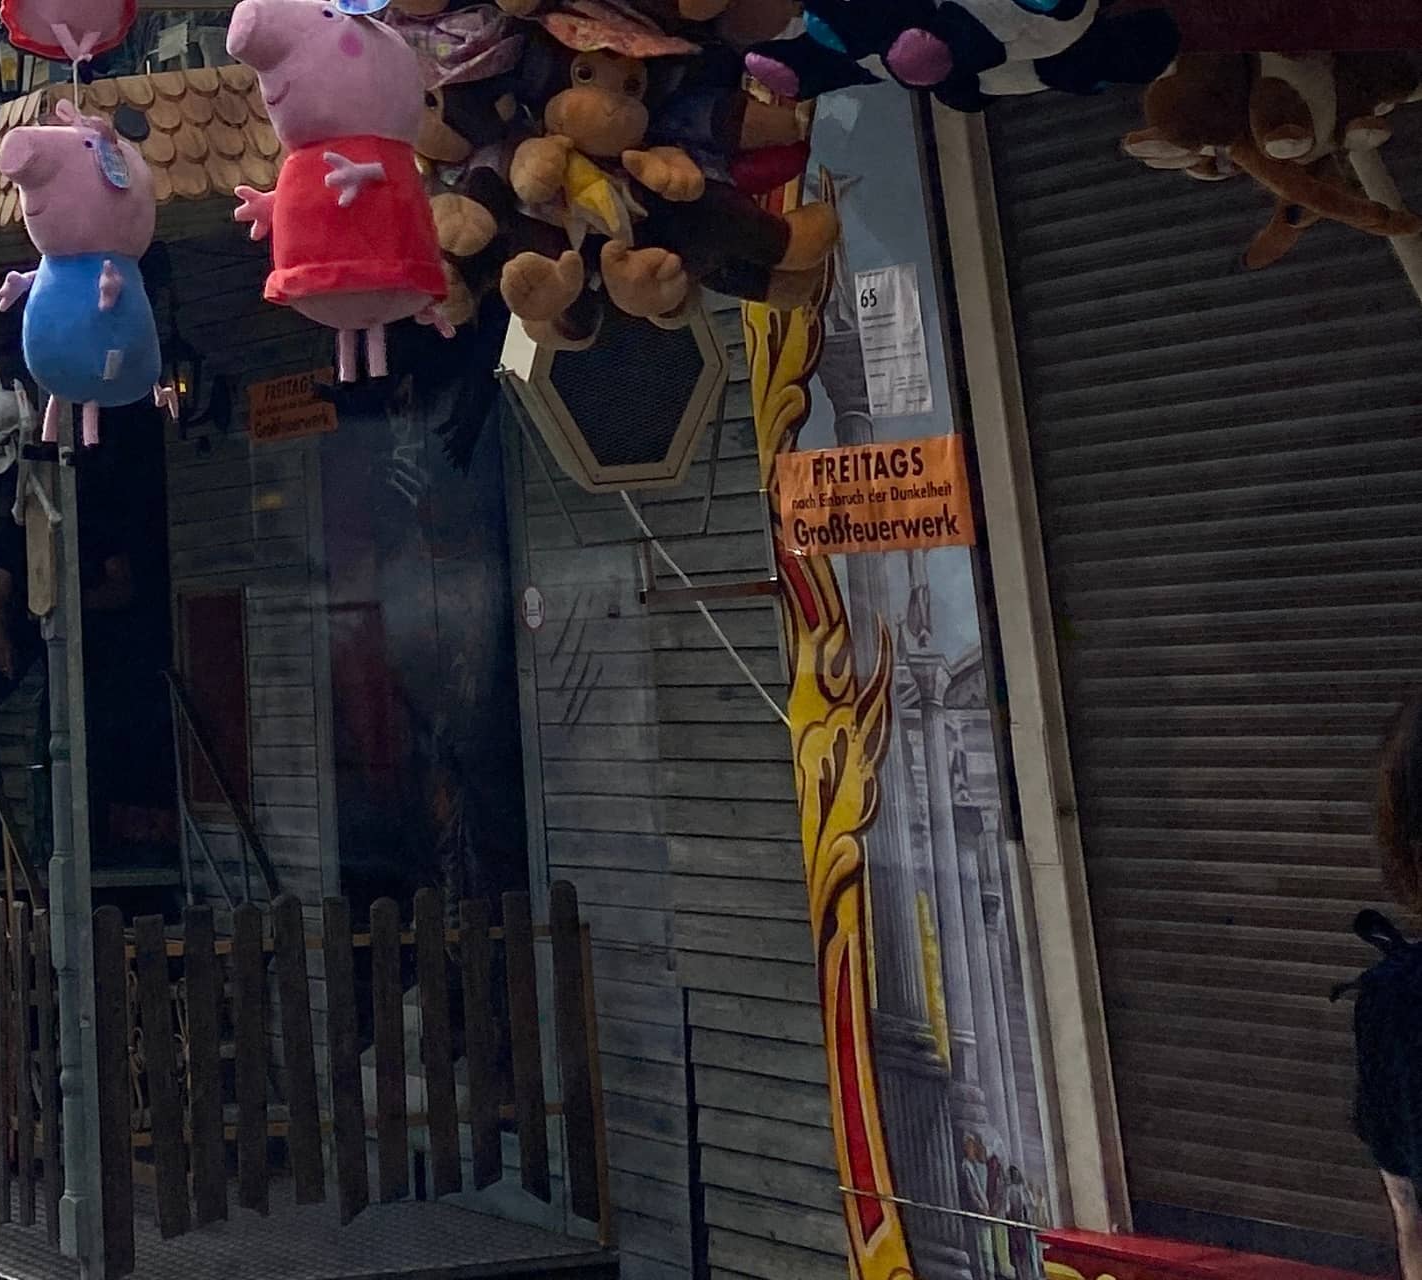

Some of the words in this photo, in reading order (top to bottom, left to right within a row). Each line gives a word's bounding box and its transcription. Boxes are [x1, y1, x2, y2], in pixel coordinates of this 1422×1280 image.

[860, 287, 878, 308] 65
[811, 446, 924, 486] FREITAGS
[792, 493, 817, 511] nach
[868, 487, 887, 503] der
[890, 480, 952, 501] Dunkelheit
[793, 503, 961, 547] Großfeuerwerk
